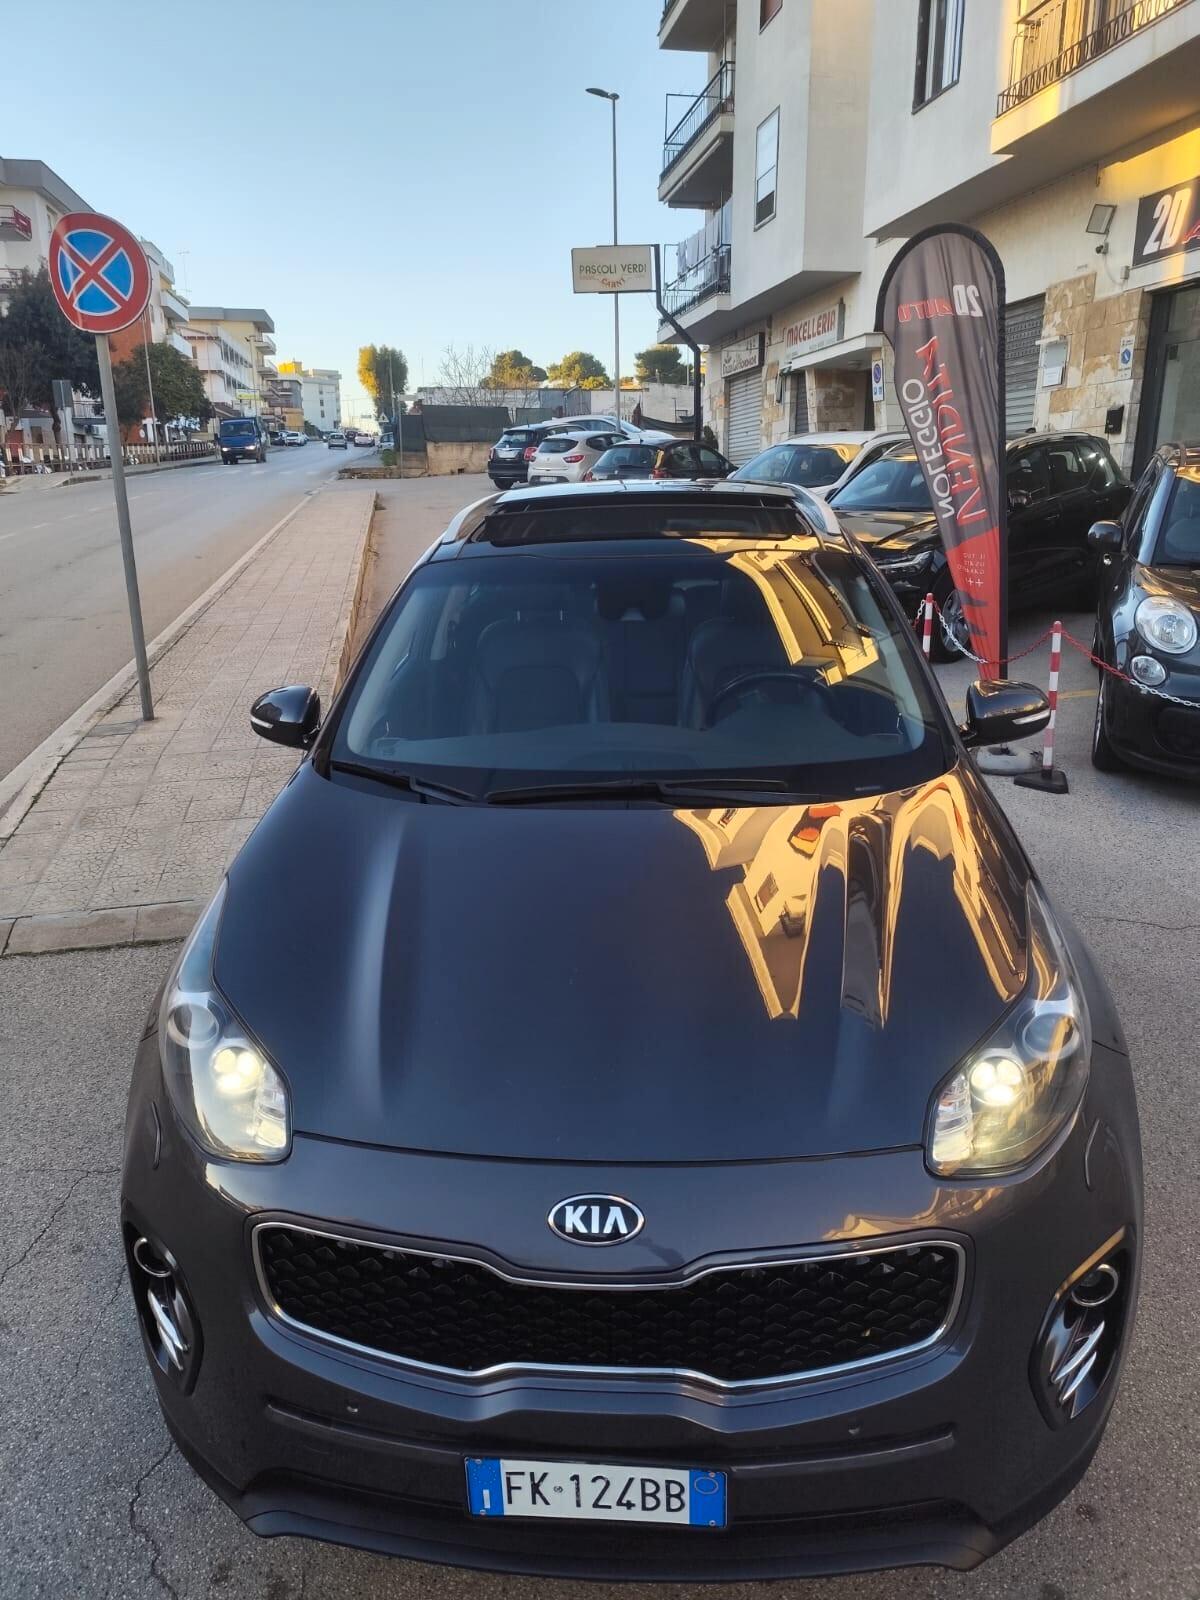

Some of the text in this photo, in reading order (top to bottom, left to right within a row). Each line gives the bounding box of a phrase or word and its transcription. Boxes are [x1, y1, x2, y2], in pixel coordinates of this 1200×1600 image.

[579, 264, 647, 274] PASCOLI VERDI
[787, 309, 836, 348] MACELLERIA
[565, 1205, 628, 1234] KIA
